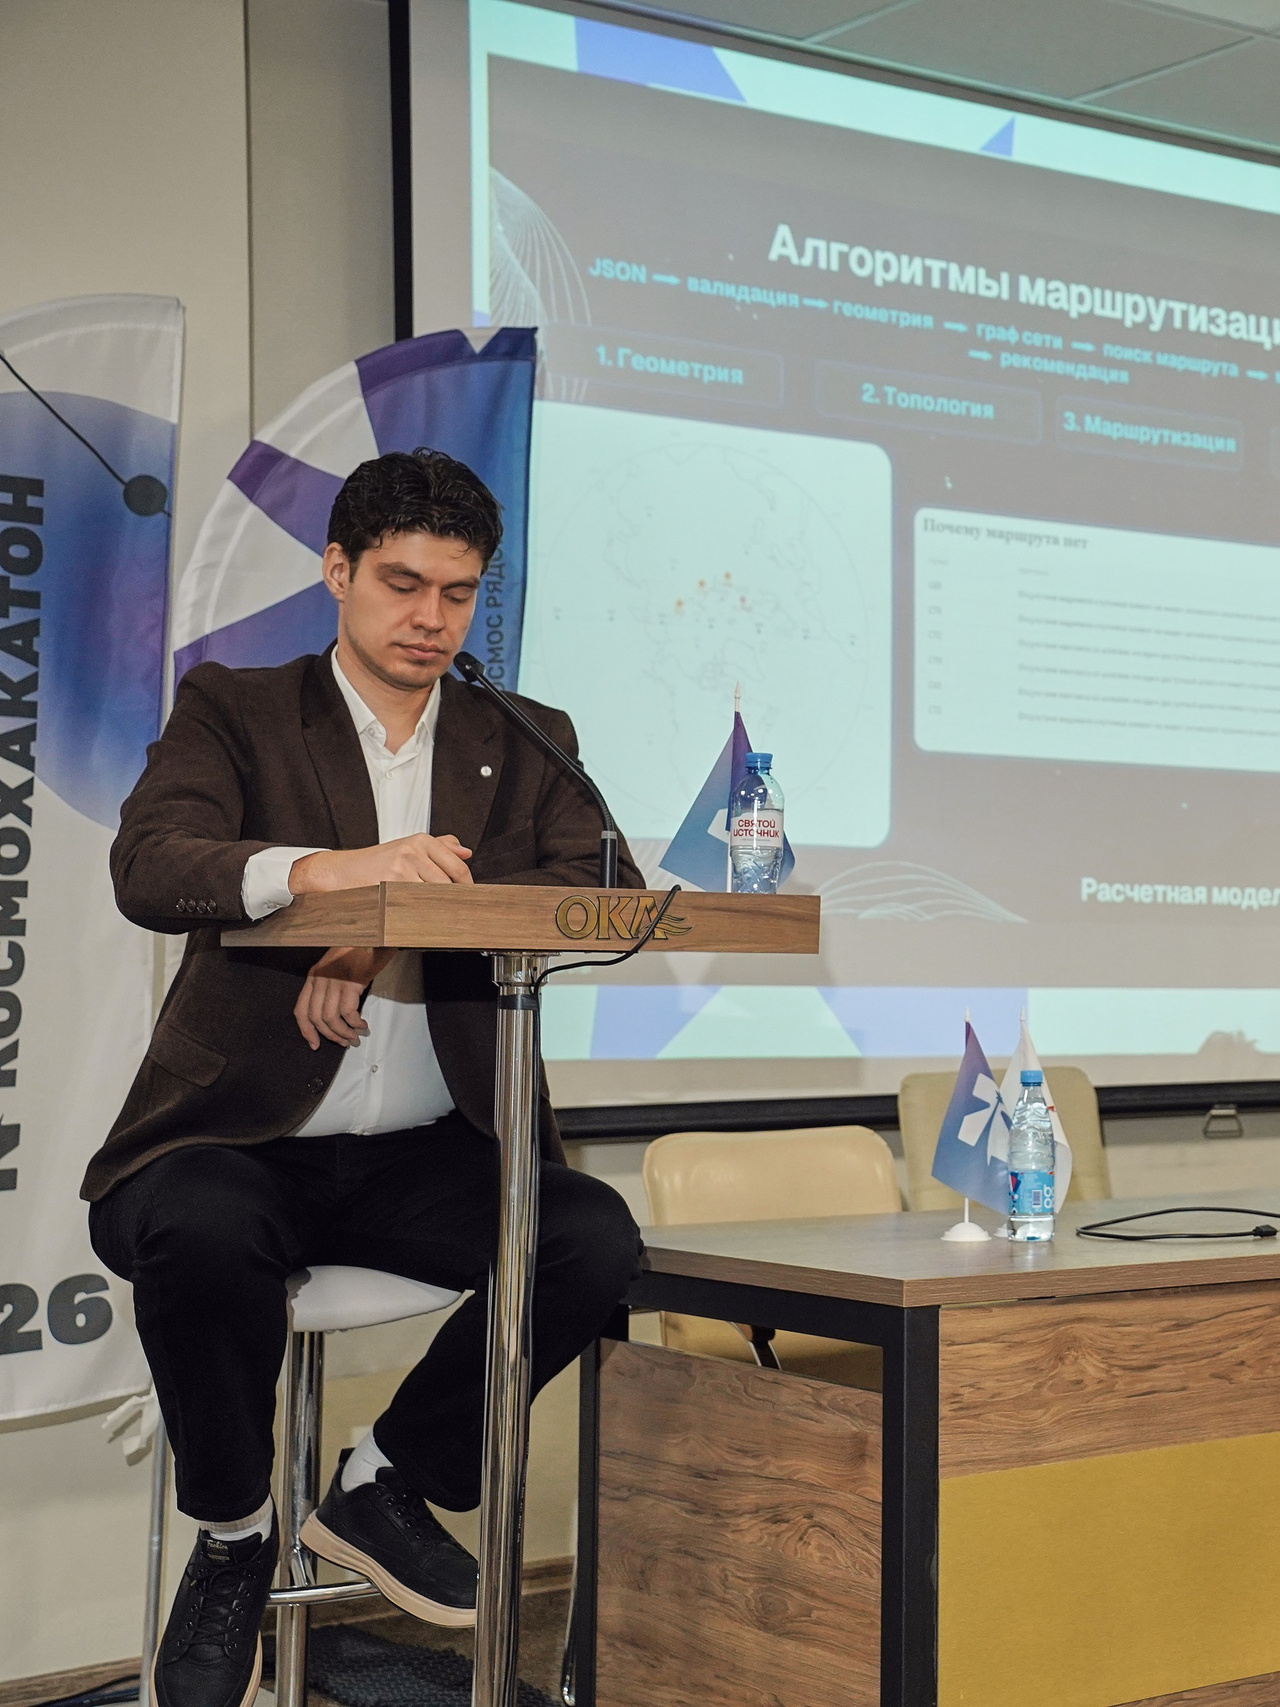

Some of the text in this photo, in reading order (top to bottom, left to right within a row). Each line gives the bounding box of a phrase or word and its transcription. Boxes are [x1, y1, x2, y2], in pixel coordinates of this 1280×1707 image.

[768, 222, 1010, 302] Алгоритмы
[588, 258, 647, 285] JSON
[687, 274, 799, 309] валидация
[832, 299, 935, 330] геометрия
[975, 320, 1020, 346] граф
[1021, 330, 1063, 351] сети
[1103, 342, 1154, 365] поиск
[1156, 350, 1240, 382] маршрута
[595, 346, 744, 386] 1. Геометрия
[999, 350, 1130, 386] рекомендация
[861, 383, 995, 420] 2. Топология
[1062, 411, 1237, 455] 3. Маршрутизация
[923, 517, 983, 541] Почему
[733, 828, 780, 838] ИСТОЧНИК
[737, 819, 776, 828] СВЯТОЙ
[1081, 877, 1207, 905] Расчетная
